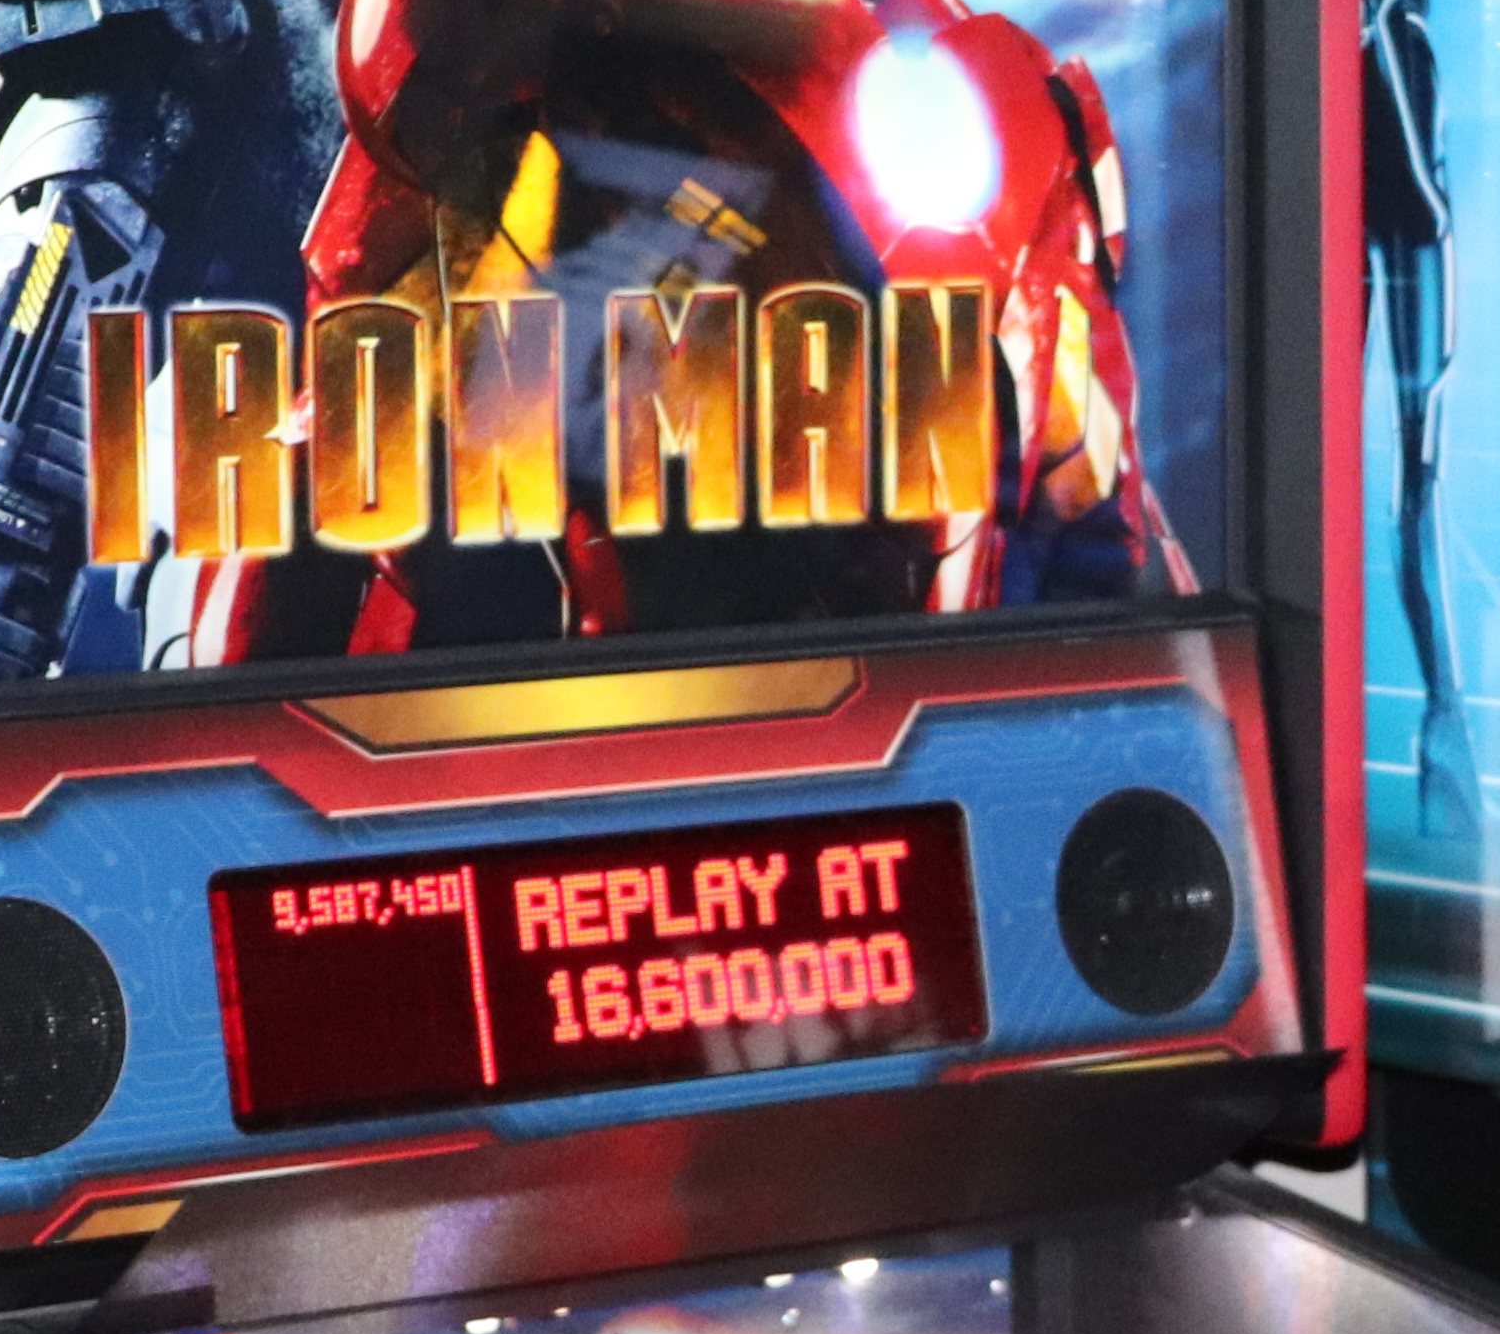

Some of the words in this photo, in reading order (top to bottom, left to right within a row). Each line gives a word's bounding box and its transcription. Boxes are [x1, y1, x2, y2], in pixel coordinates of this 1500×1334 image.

[87, 292, 565, 567] IRON
[605, 282, 997, 535] MAN
[271, 872, 464, 936] 9,587,450
[513, 852, 788, 952] REPLAY
[816, 839, 910, 921] AT
[546, 930, 915, 1045] 16,600,000
